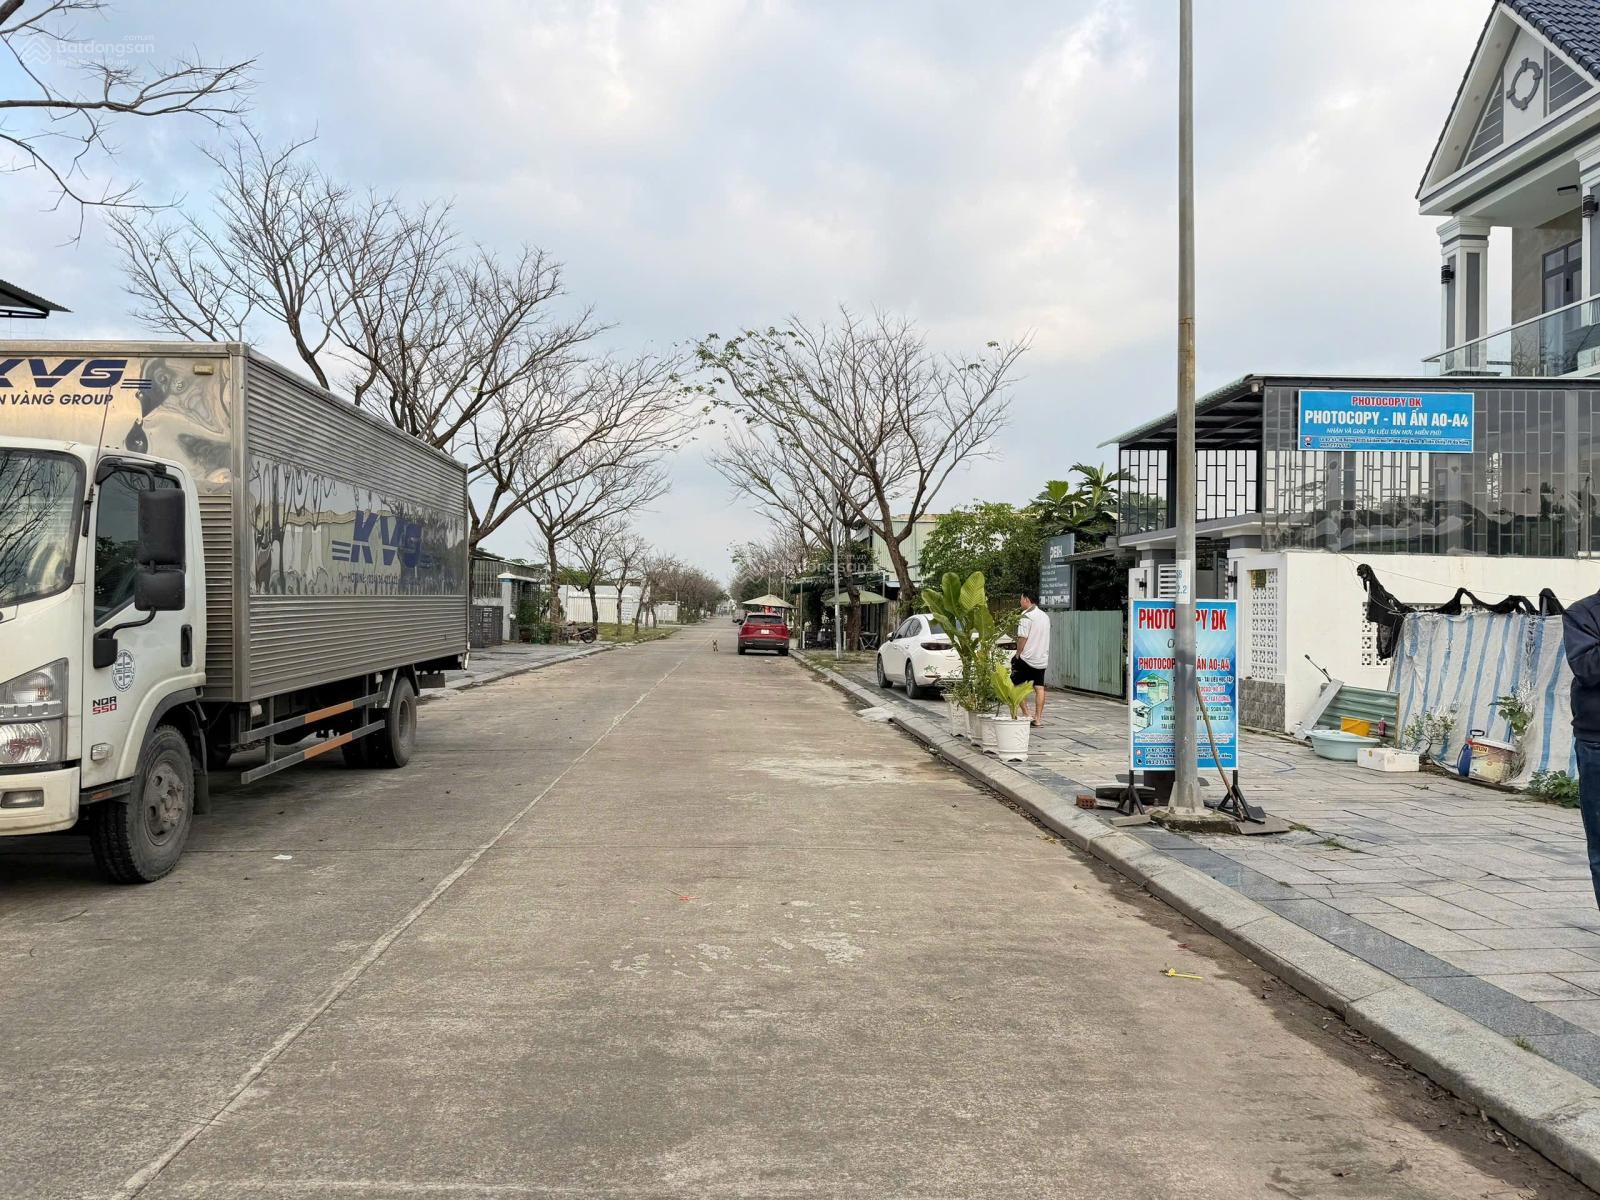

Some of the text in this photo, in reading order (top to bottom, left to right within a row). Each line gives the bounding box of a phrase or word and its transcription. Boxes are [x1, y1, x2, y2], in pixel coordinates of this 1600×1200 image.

[60, 394, 114, 405] GROUP
[1352, 396, 1407, 407] PHOTOCOPY
[1304, 410, 1380, 426] PHOTOCOPY
[1392, 412, 1406, 426] IN
[1211, 610, 1227, 630] ĐK
[93, 696, 117, 707] NQR
